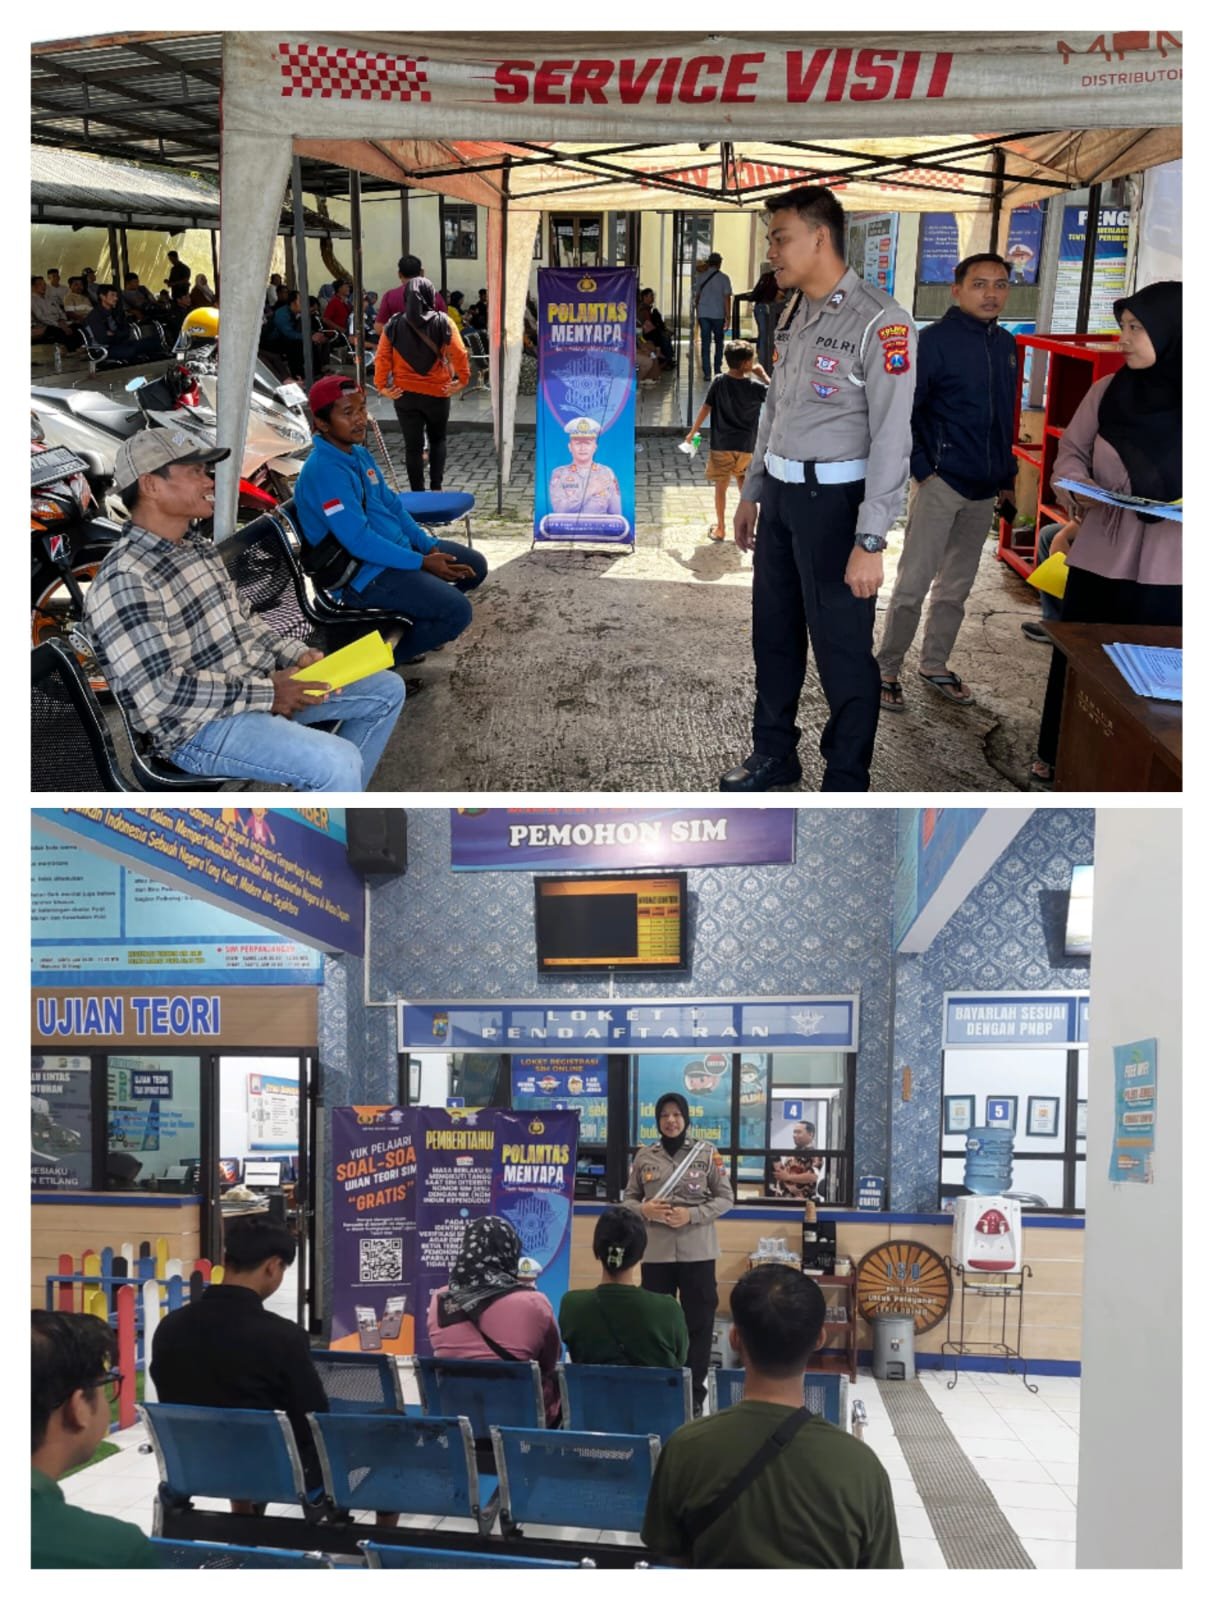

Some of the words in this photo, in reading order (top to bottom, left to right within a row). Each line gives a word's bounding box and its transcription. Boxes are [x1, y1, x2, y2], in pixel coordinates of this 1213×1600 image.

[494, 52, 765, 105] SERVICE
[786, 49, 953, 103] VISIT
[1081, 69, 1182, 87] DISTRIBUTO
[548, 302, 627, 323] POLANTAS
[551, 324, 622, 342] MENYAPA
[815, 336, 856, 354] POLRI
[105, 808, 148, 843] Indonesia
[145, 832, 178, 856] Sebuah
[178, 845, 204, 870] Negara
[509, 821, 662, 847] PEMOHON
[671, 819, 727, 842] SIM
[37, 997, 124, 1036] UJIAN
[131, 996, 220, 1035] TEORI
[547, 1009, 665, 1021] LOKET
[955, 1007, 1017, 1021] BAYARLAH
[1021, 1006, 1066, 1020] SESUAI
[481, 1025, 770, 1040] PENDAFTARAN
[966, 1022, 1016, 1036] DENGAN
[789, 1104, 798, 1117] 4
[995, 1105, 1004, 1118] 5
[350, 1146, 369, 1160] YUK
[371, 1135, 412, 1155] PELAJARI
[502, 1144, 570, 1165] POLANTAS
[344, 1175, 371, 1192] UJIAN
[373, 1168, 399, 1184] TEORI
[503, 1164, 564, 1184] MENYAPA
